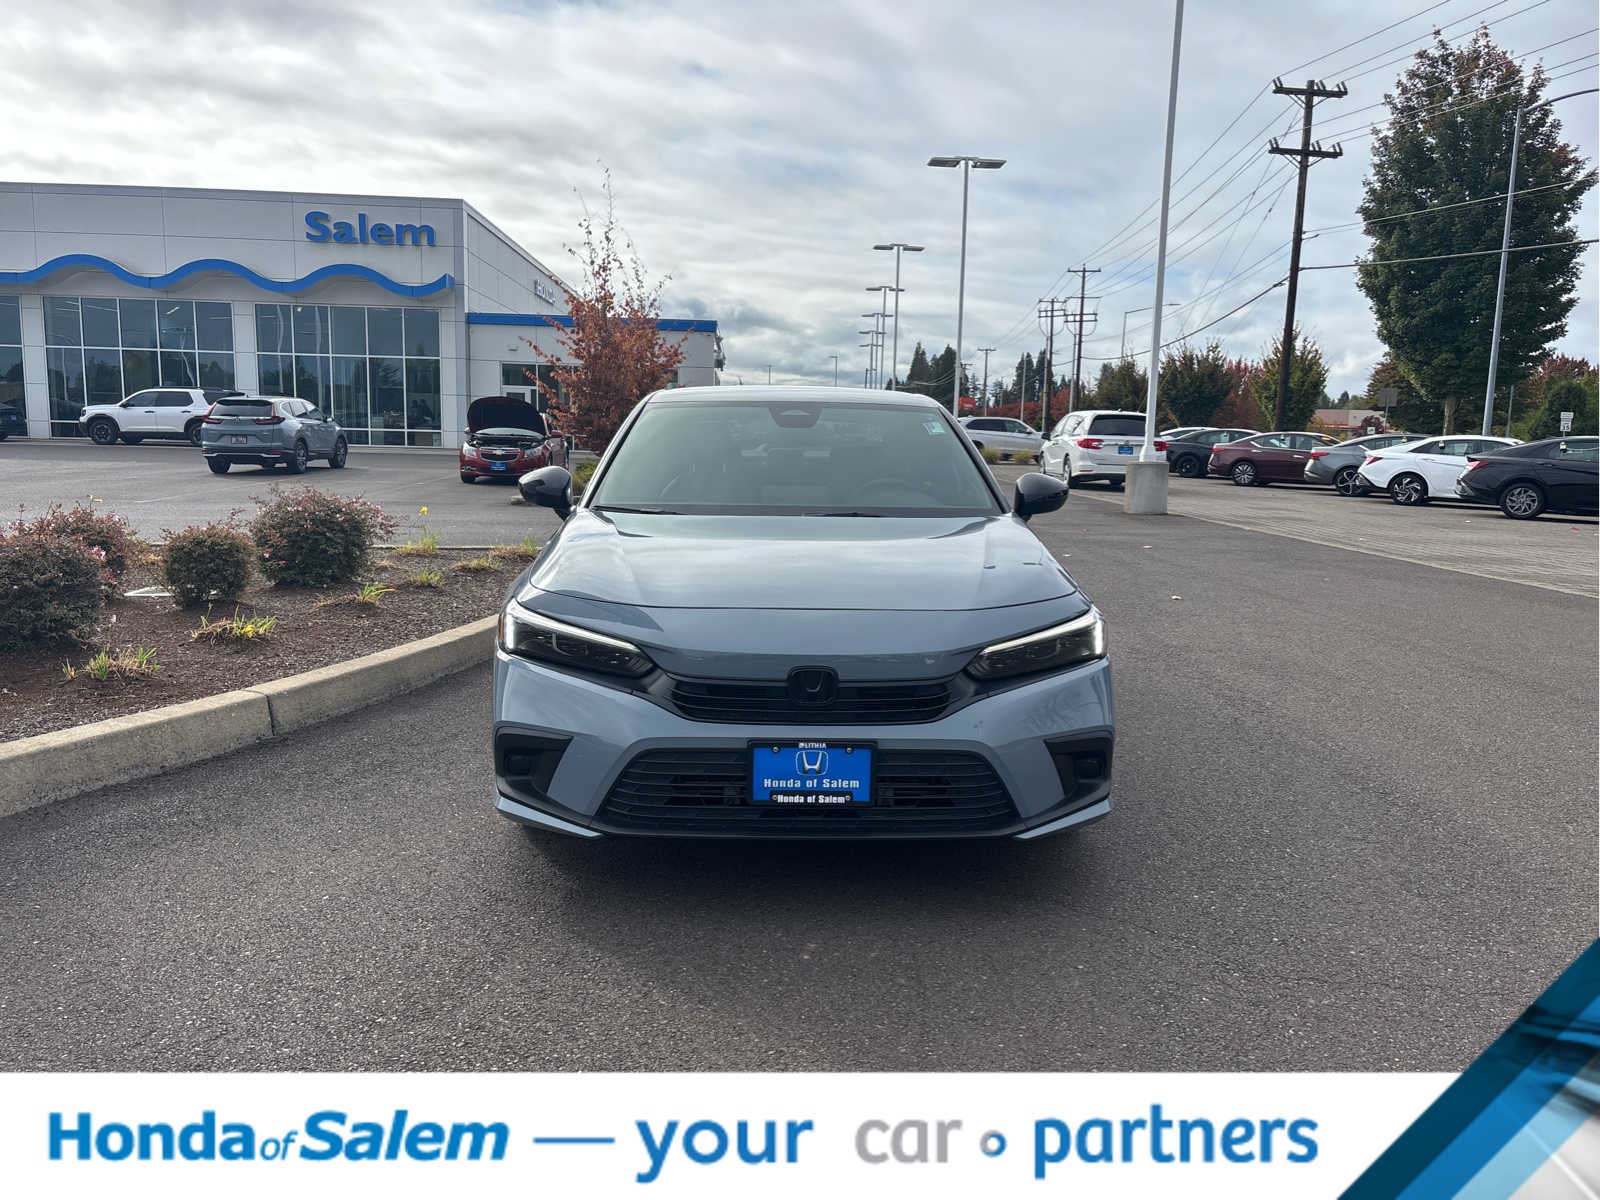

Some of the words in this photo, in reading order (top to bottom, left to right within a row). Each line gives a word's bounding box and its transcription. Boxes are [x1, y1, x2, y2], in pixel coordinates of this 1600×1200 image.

[305, 211, 436, 246] Salem
[764, 778, 801, 788] Honda
[806, 778, 817, 788] of
[823, 778, 860, 788] Salem
[777, 794, 804, 803] Honda
[807, 795, 816, 803] of
[818, 795, 846, 804] Salem
